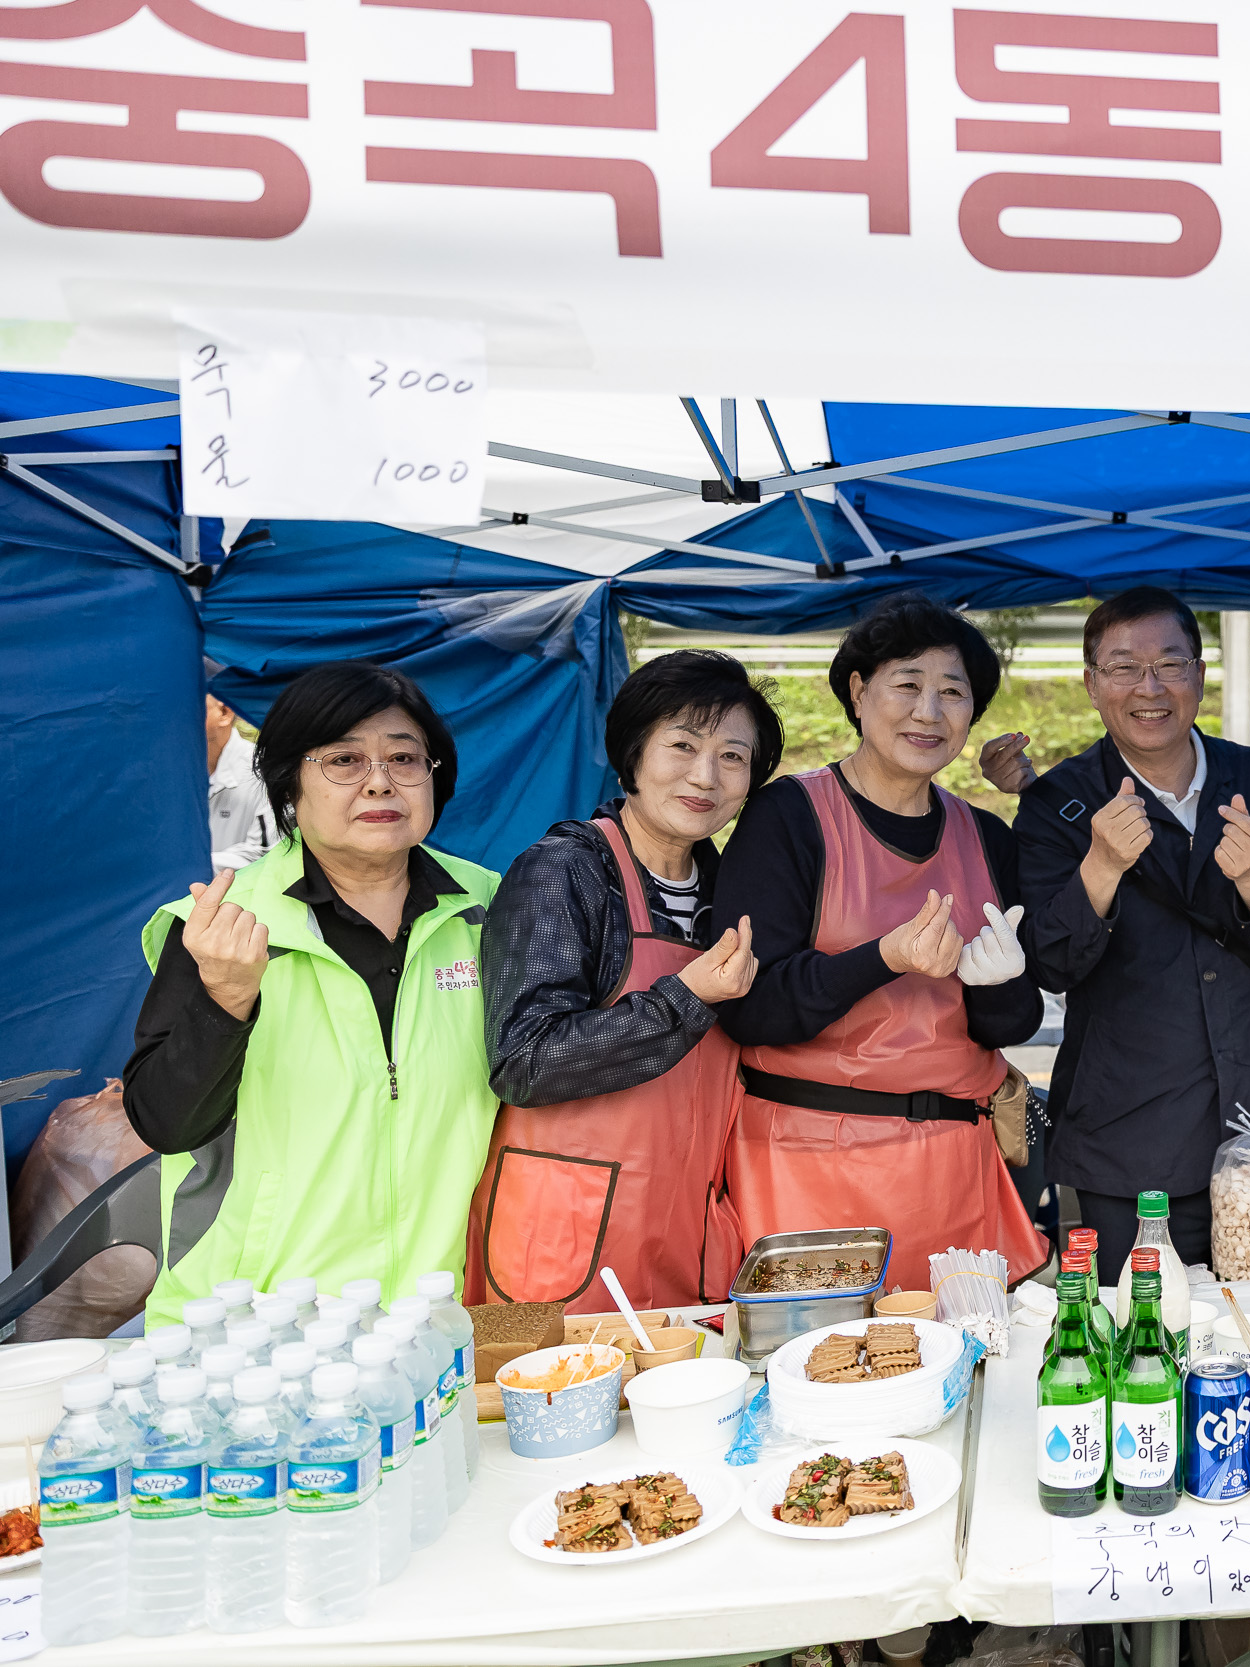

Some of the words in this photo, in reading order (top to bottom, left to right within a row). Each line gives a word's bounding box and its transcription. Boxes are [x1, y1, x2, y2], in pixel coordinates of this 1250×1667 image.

[0, 0, 1223, 278] 중곡4동
[368, 360, 474, 398] 3000
[374, 458, 469, 486] 1000
[1074, 1466, 1098, 1481] fresh
[1139, 1467, 1165, 1480] fresh
